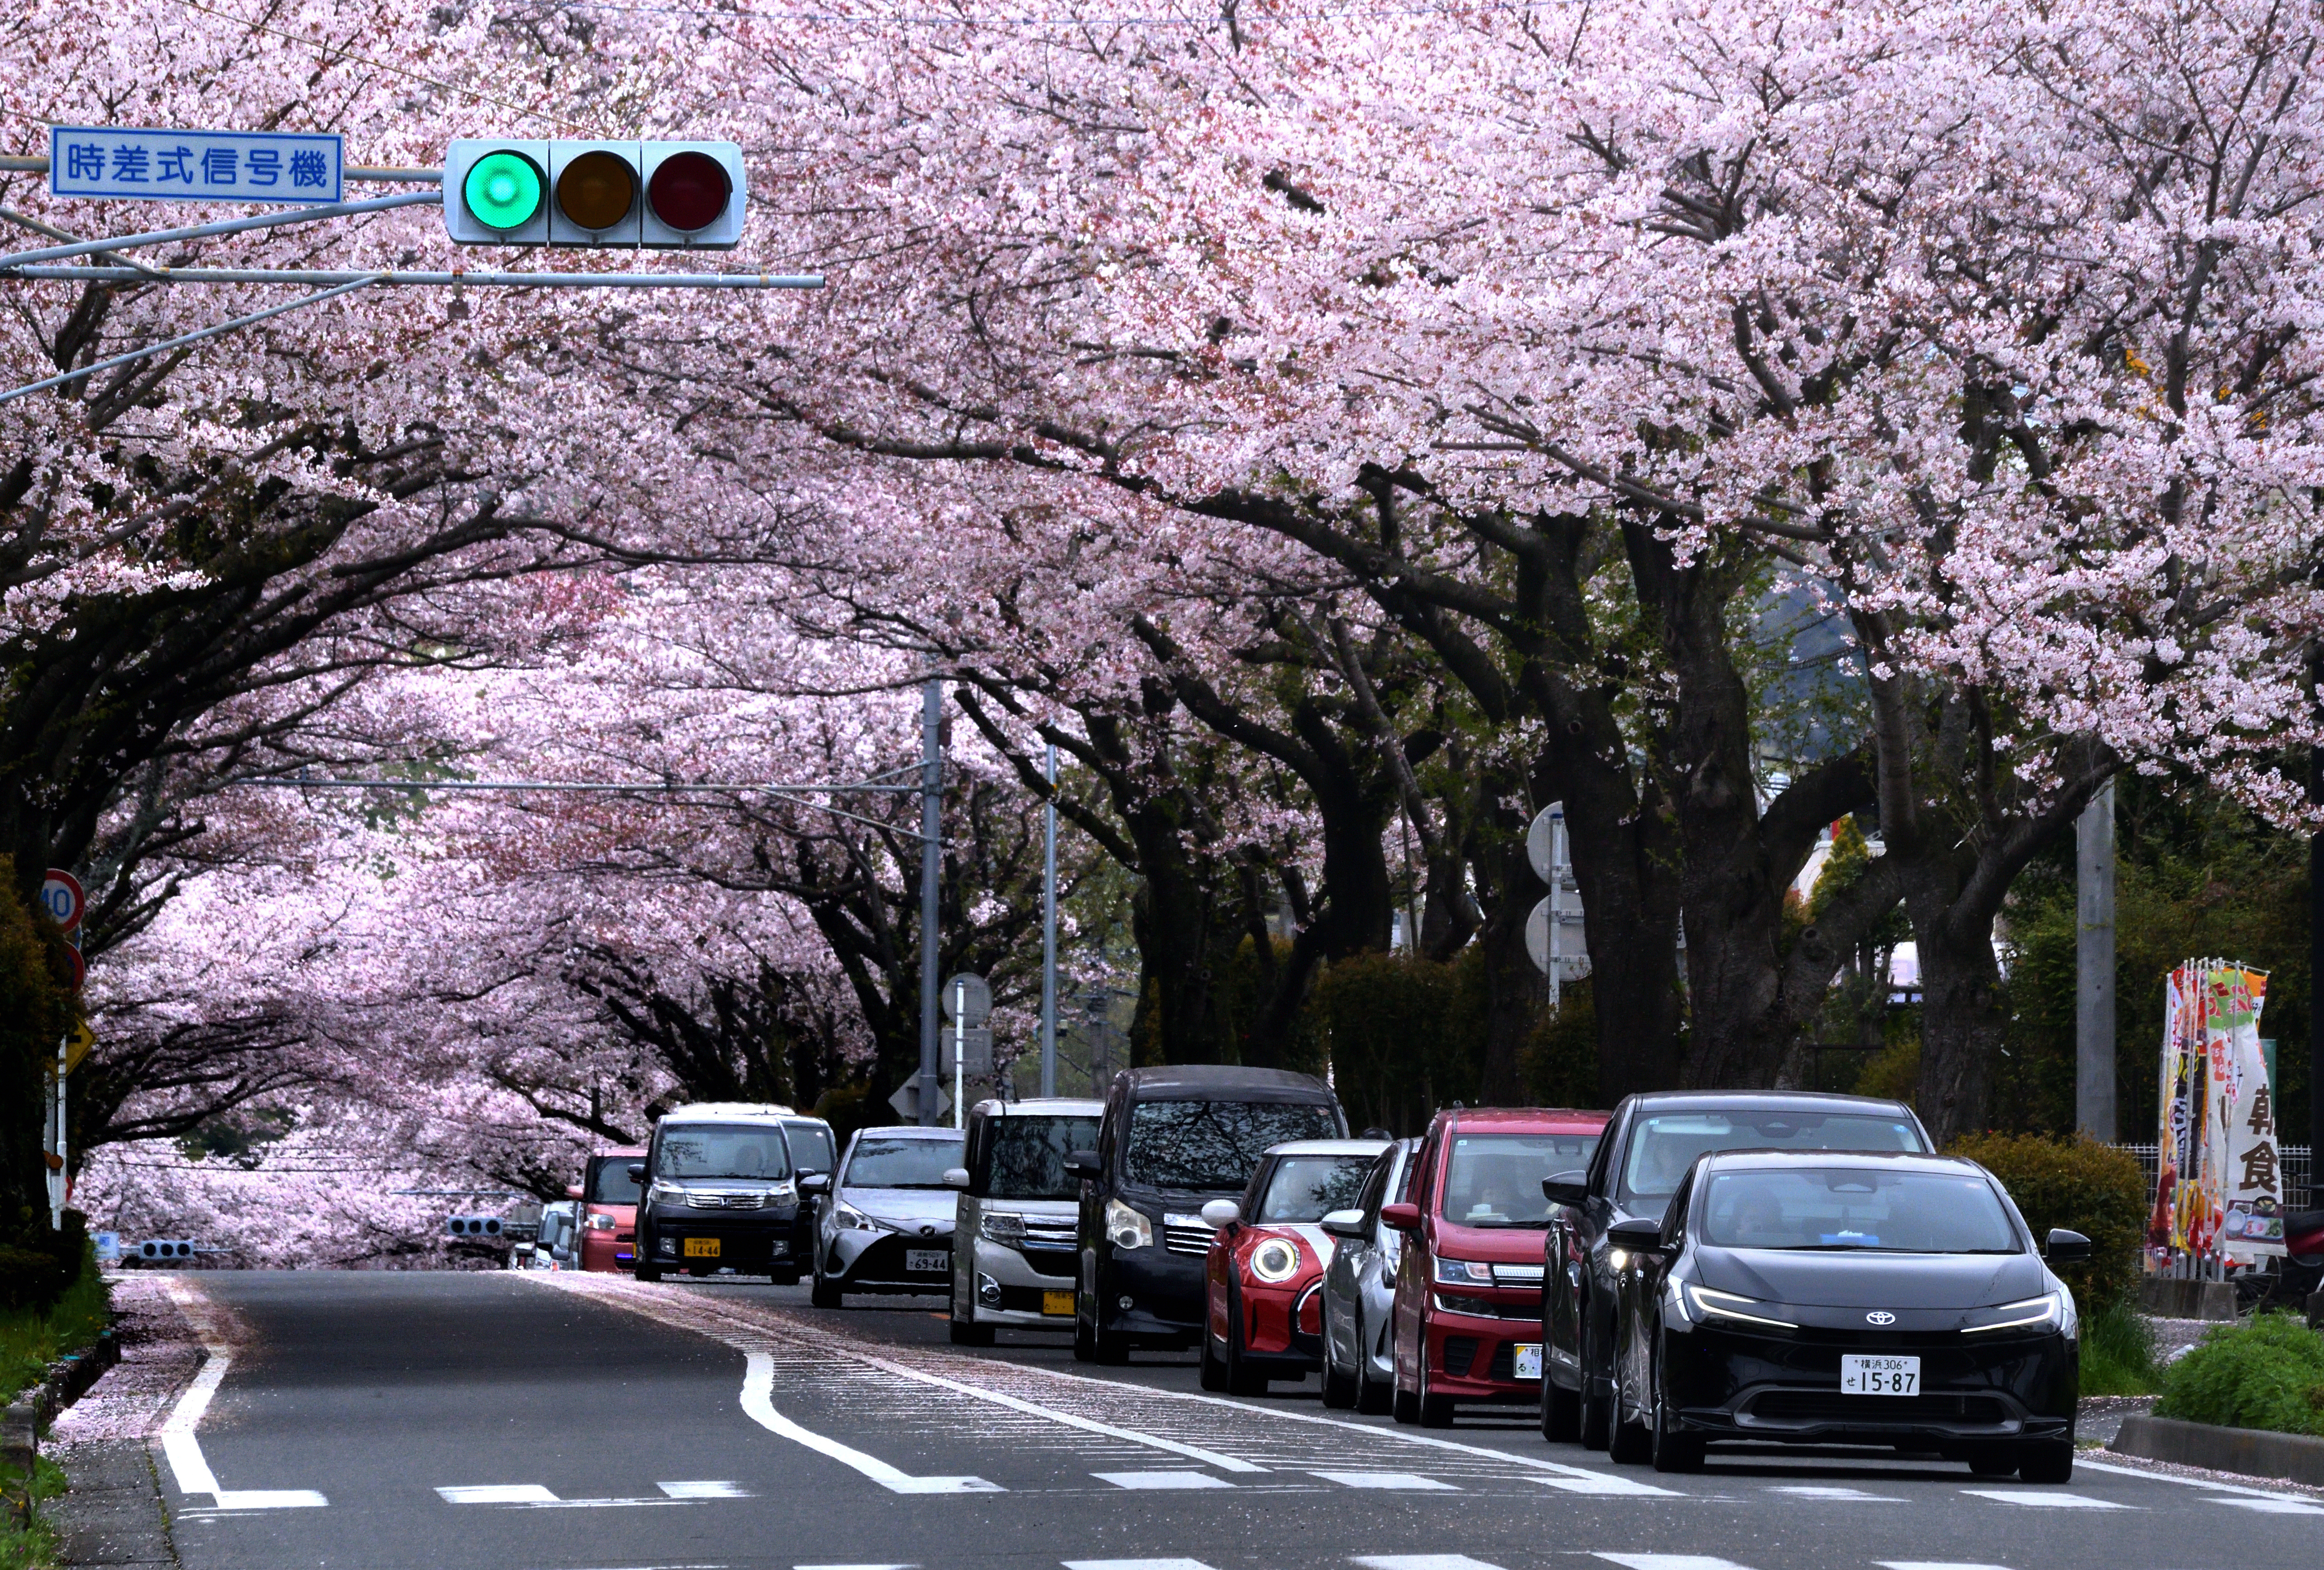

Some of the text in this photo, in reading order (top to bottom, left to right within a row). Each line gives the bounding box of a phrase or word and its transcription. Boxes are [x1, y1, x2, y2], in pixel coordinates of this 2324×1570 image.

[68, 143, 327, 187] 時差式信号機
[915, 1259, 946, 1269] 69-44
[1530, 1348, 1542, 1357] 相
[1518, 1363, 1526, 1372] る
[1847, 1372, 1916, 1393] せ 15-87
